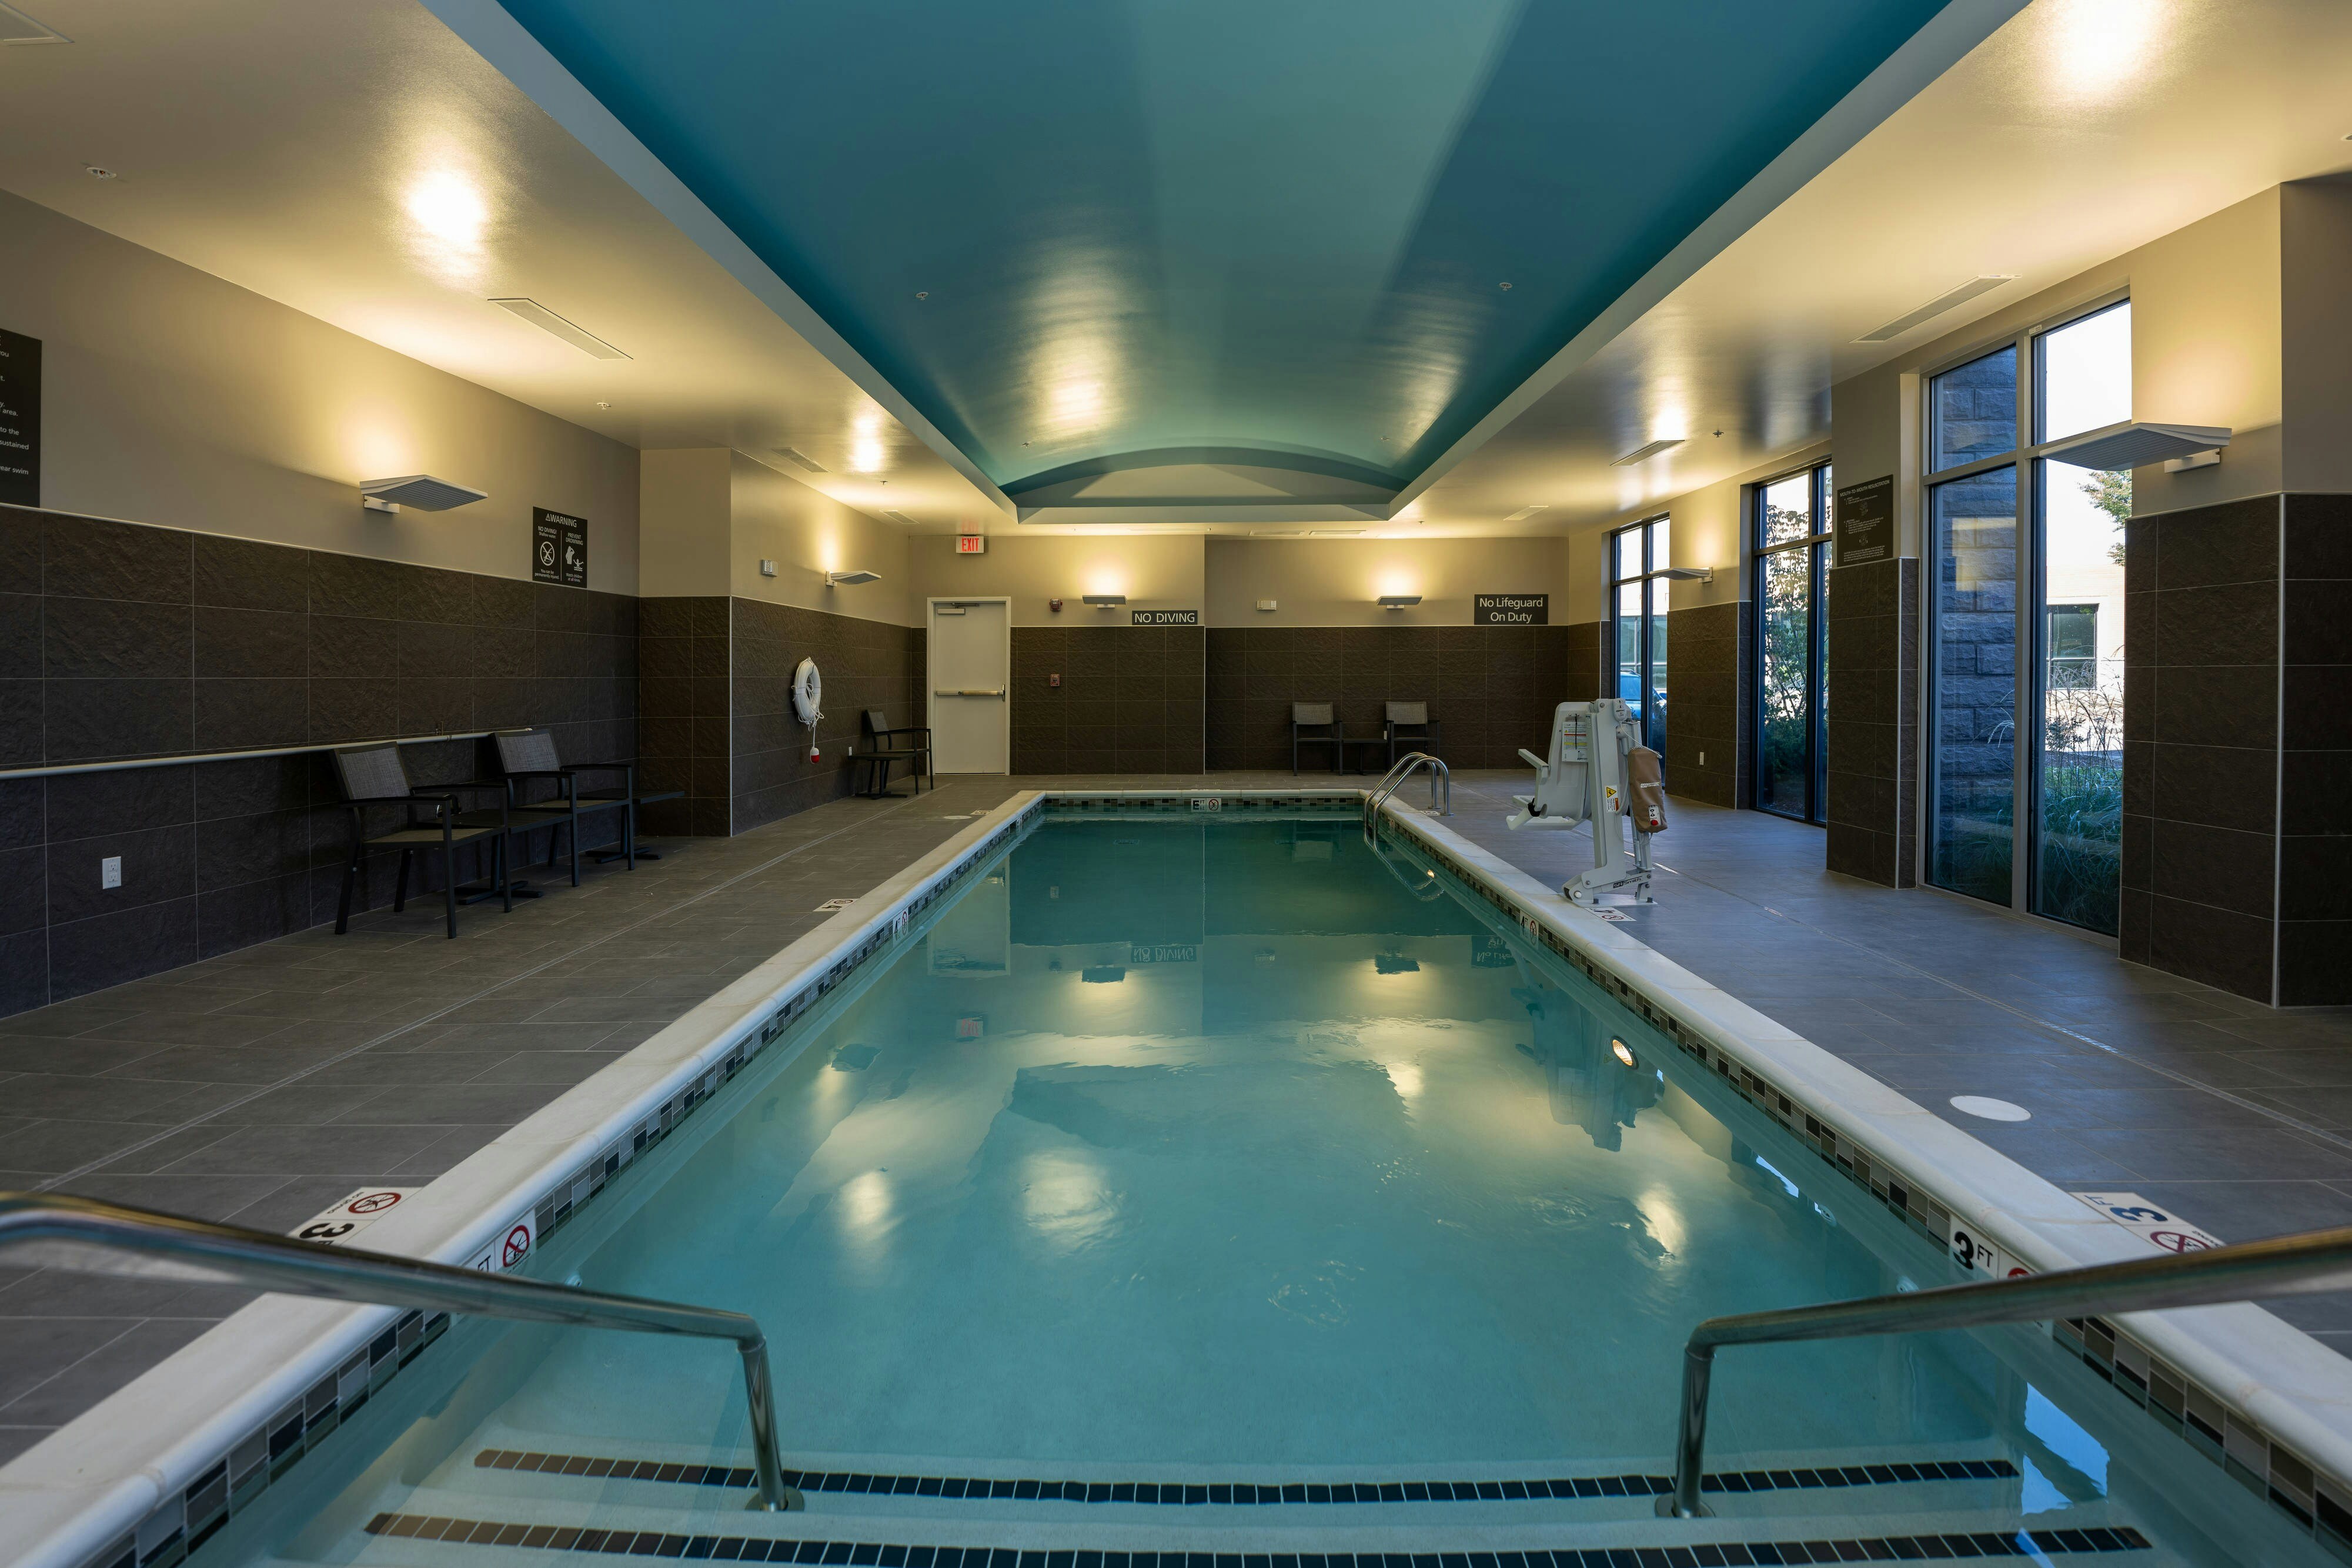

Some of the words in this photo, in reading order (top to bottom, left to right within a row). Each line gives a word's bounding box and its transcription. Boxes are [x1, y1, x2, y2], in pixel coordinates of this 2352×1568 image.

[550, 514, 577, 527] WARNING
[961, 537, 979, 551] EXIT
[1479, 597, 1494, 607] No
[1496, 597, 1543, 610] Lifeguard
[1135, 613, 1151, 623] NO
[1156, 613, 1195, 623] DIVING
[1491, 612, 1505, 621] On
[1508, 612, 1532, 624] Duty
[894, 920, 898, 934] 4
[1521, 916, 1525, 929] 4
[2084, 1195, 2114, 1205] FT
[2109, 1206, 2169, 1222] 3
[299, 1222, 355, 1238] 3
[1953, 1231, 1974, 1270] 3
[1977, 1243, 1993, 1268] FT
